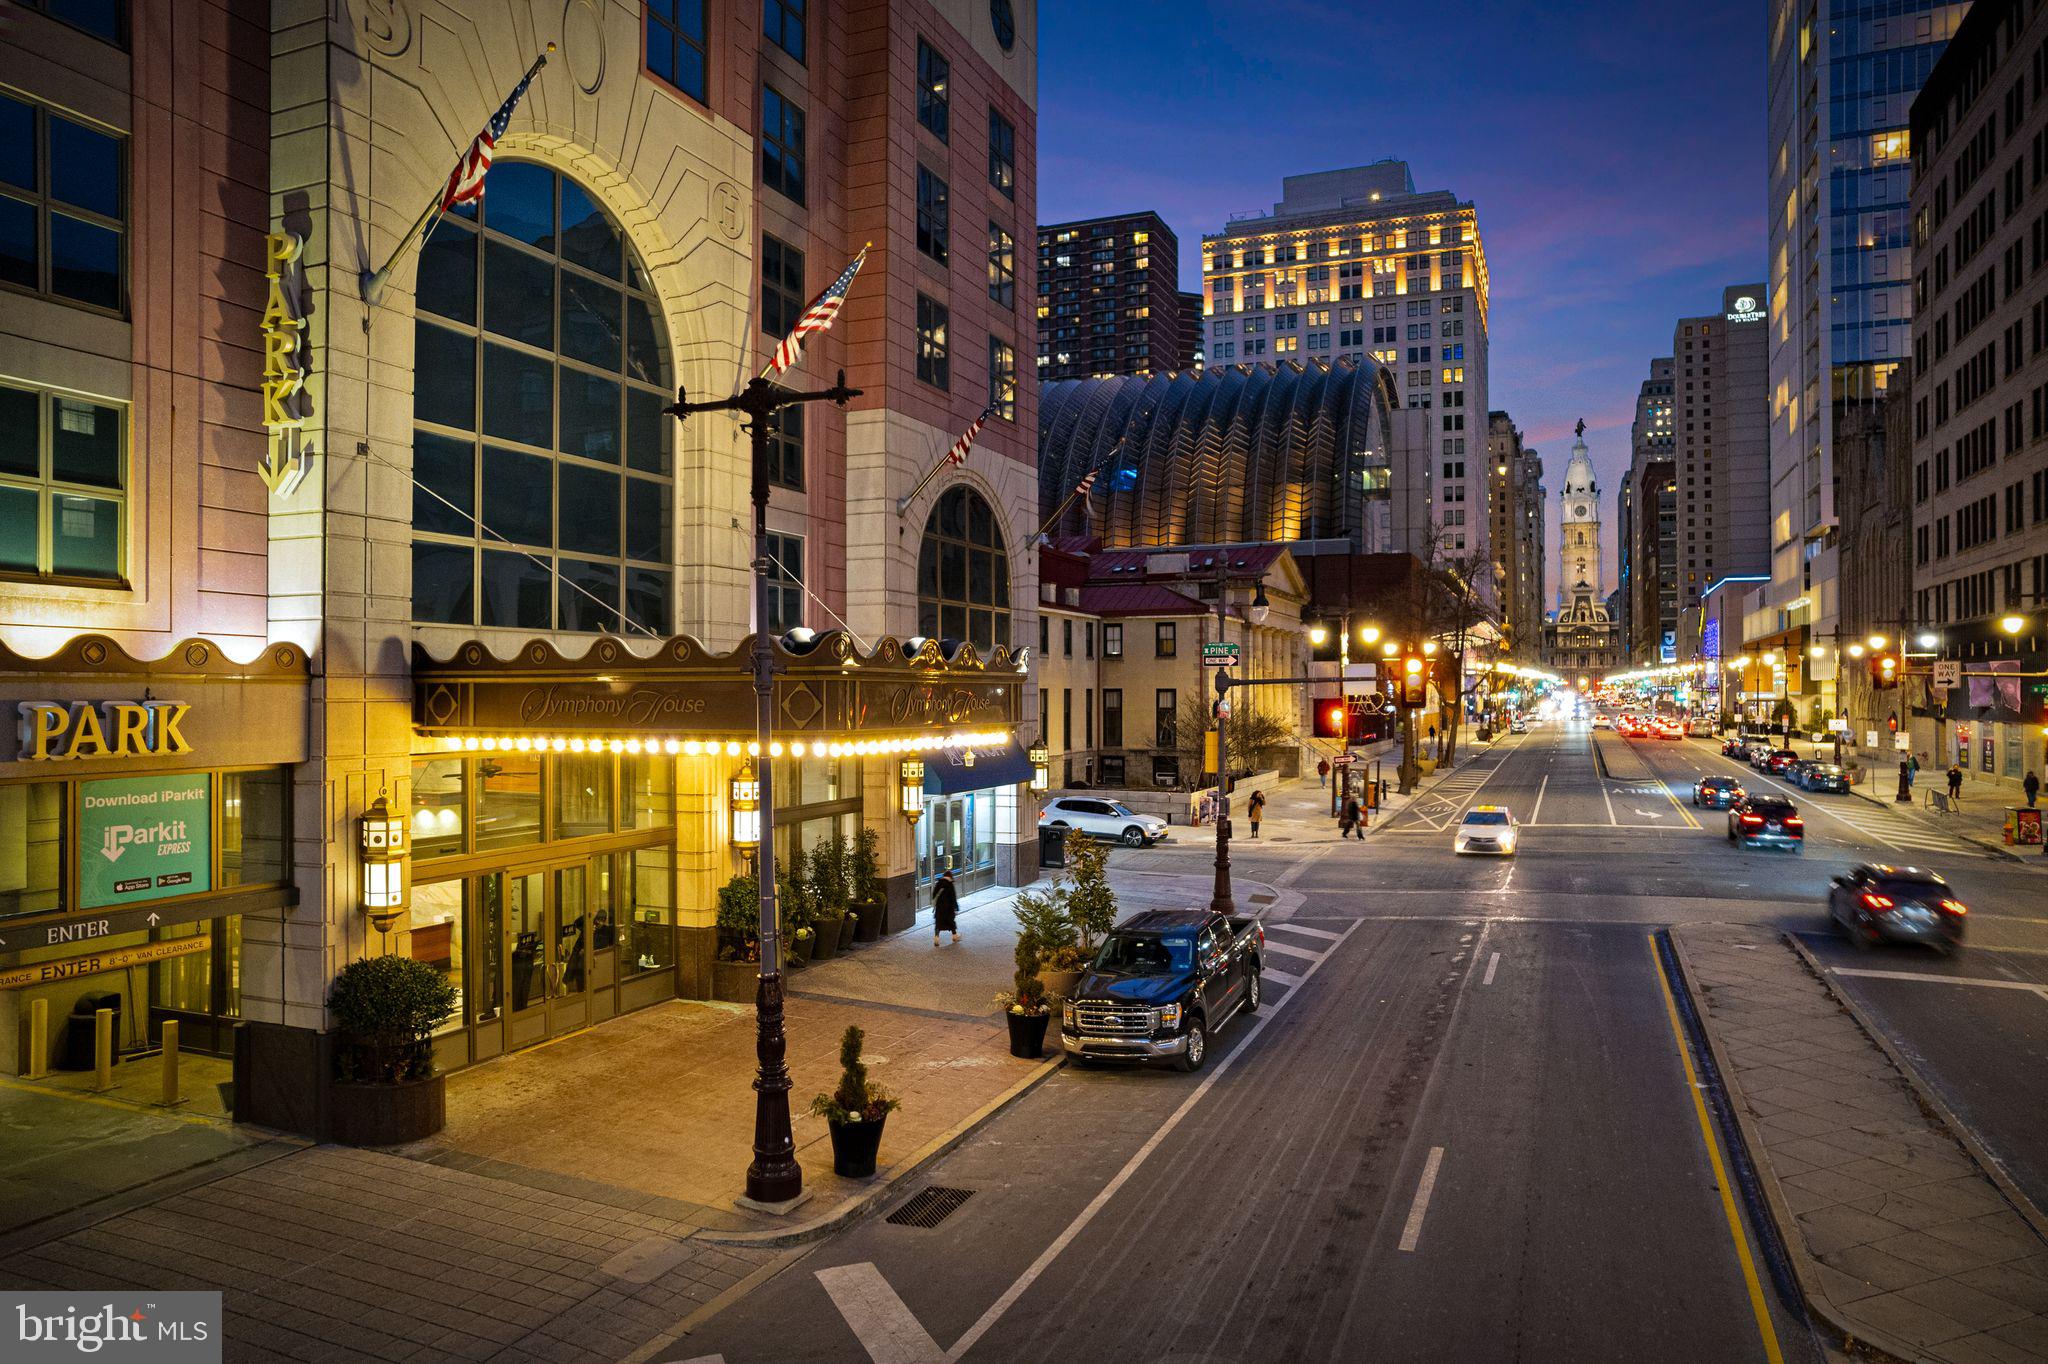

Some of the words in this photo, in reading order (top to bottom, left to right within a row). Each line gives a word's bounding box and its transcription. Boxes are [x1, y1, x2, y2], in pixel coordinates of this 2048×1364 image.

[258, 230, 302, 427] PARK
[520, 684, 626, 727] Symphony
[626, 690, 705, 726] House
[891, 684, 953, 726] Symphony
[30, 703, 195, 760] PARK
[85, 792, 158, 808] Download
[161, 788, 205, 802] iParkit
[157, 841, 192, 856] EXPRESS
[47, 919, 110, 945] ENTER
[40, 958, 101, 981] ENTER
[137, 951, 153, 960] VAN
[156, 940, 204, 956] CLEARANCE
